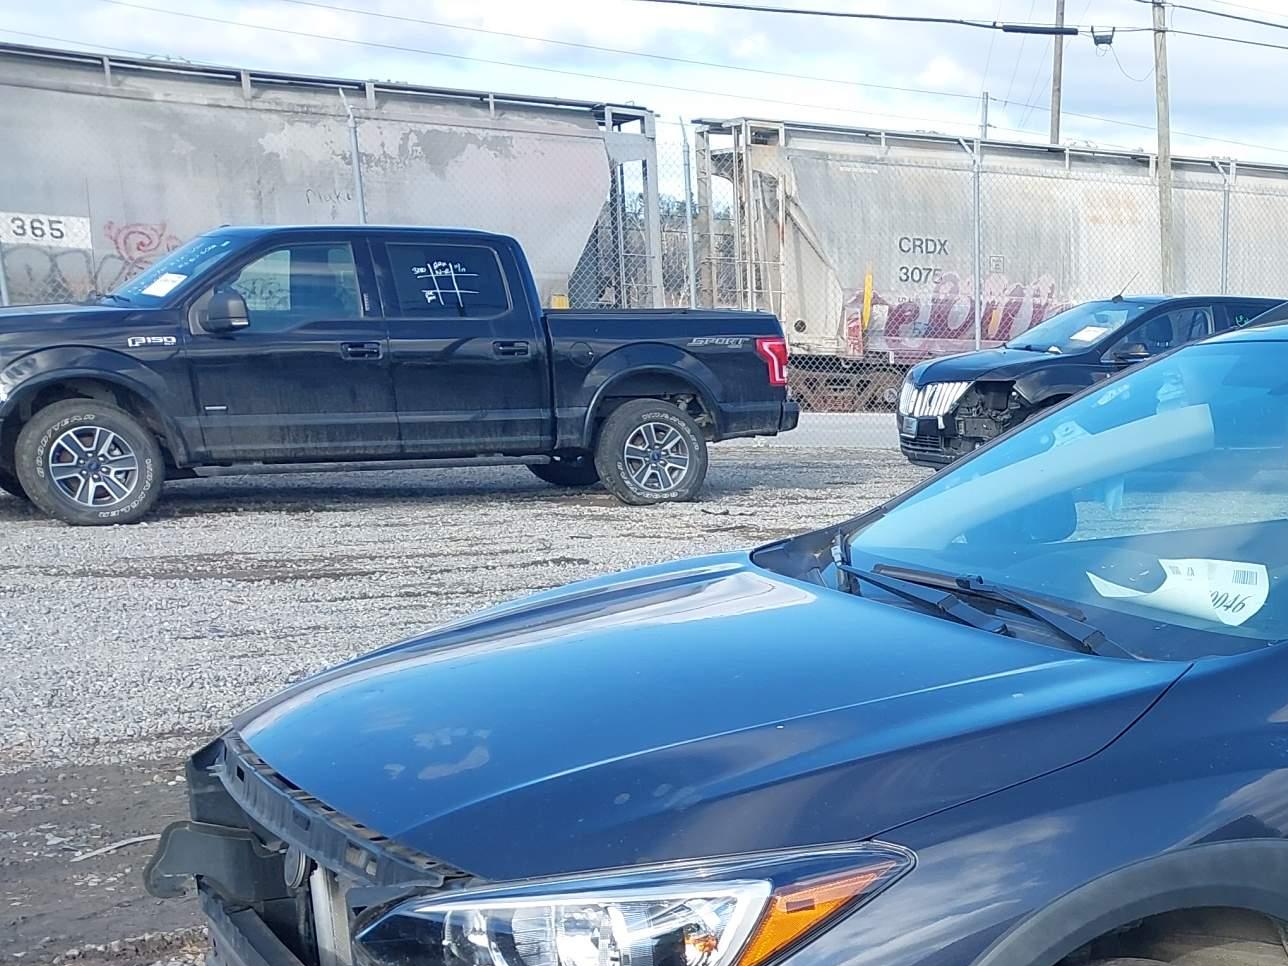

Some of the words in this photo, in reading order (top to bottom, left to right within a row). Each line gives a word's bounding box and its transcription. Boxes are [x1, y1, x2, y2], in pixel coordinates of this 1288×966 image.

[11, 217, 65, 240] 365
[898, 236, 949, 255] CRDX
[686, 337, 750, 347] SPORT
